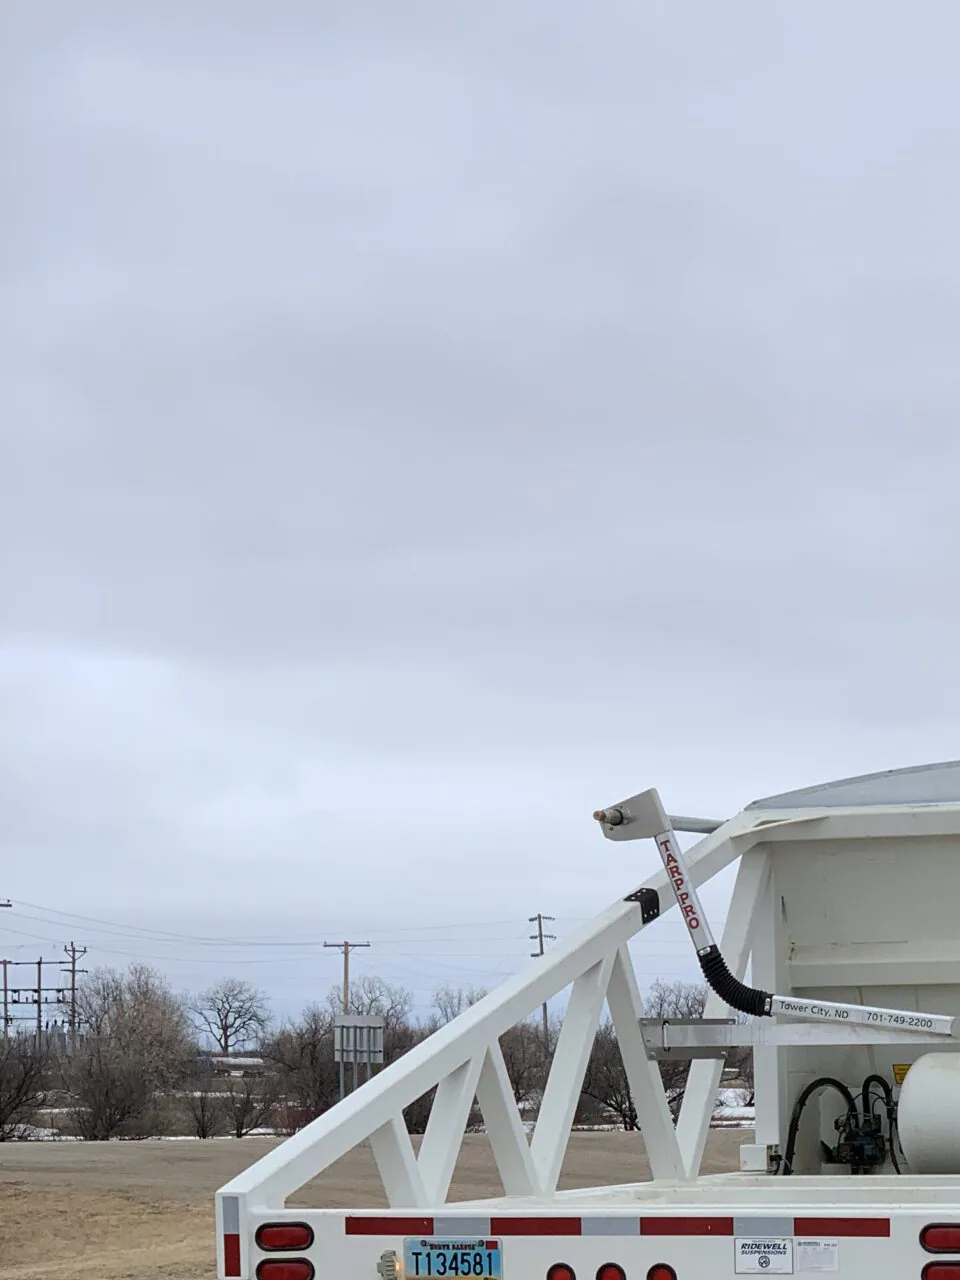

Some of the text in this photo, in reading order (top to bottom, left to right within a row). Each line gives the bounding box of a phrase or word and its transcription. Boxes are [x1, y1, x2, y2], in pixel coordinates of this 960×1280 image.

[660, 840, 700, 930] TARP PRO
[779, 1001, 849, 1019] Tower City, ND
[866, 1012, 933, 1028] 701-749-2200
[411, 1252, 493, 1276] T134581
